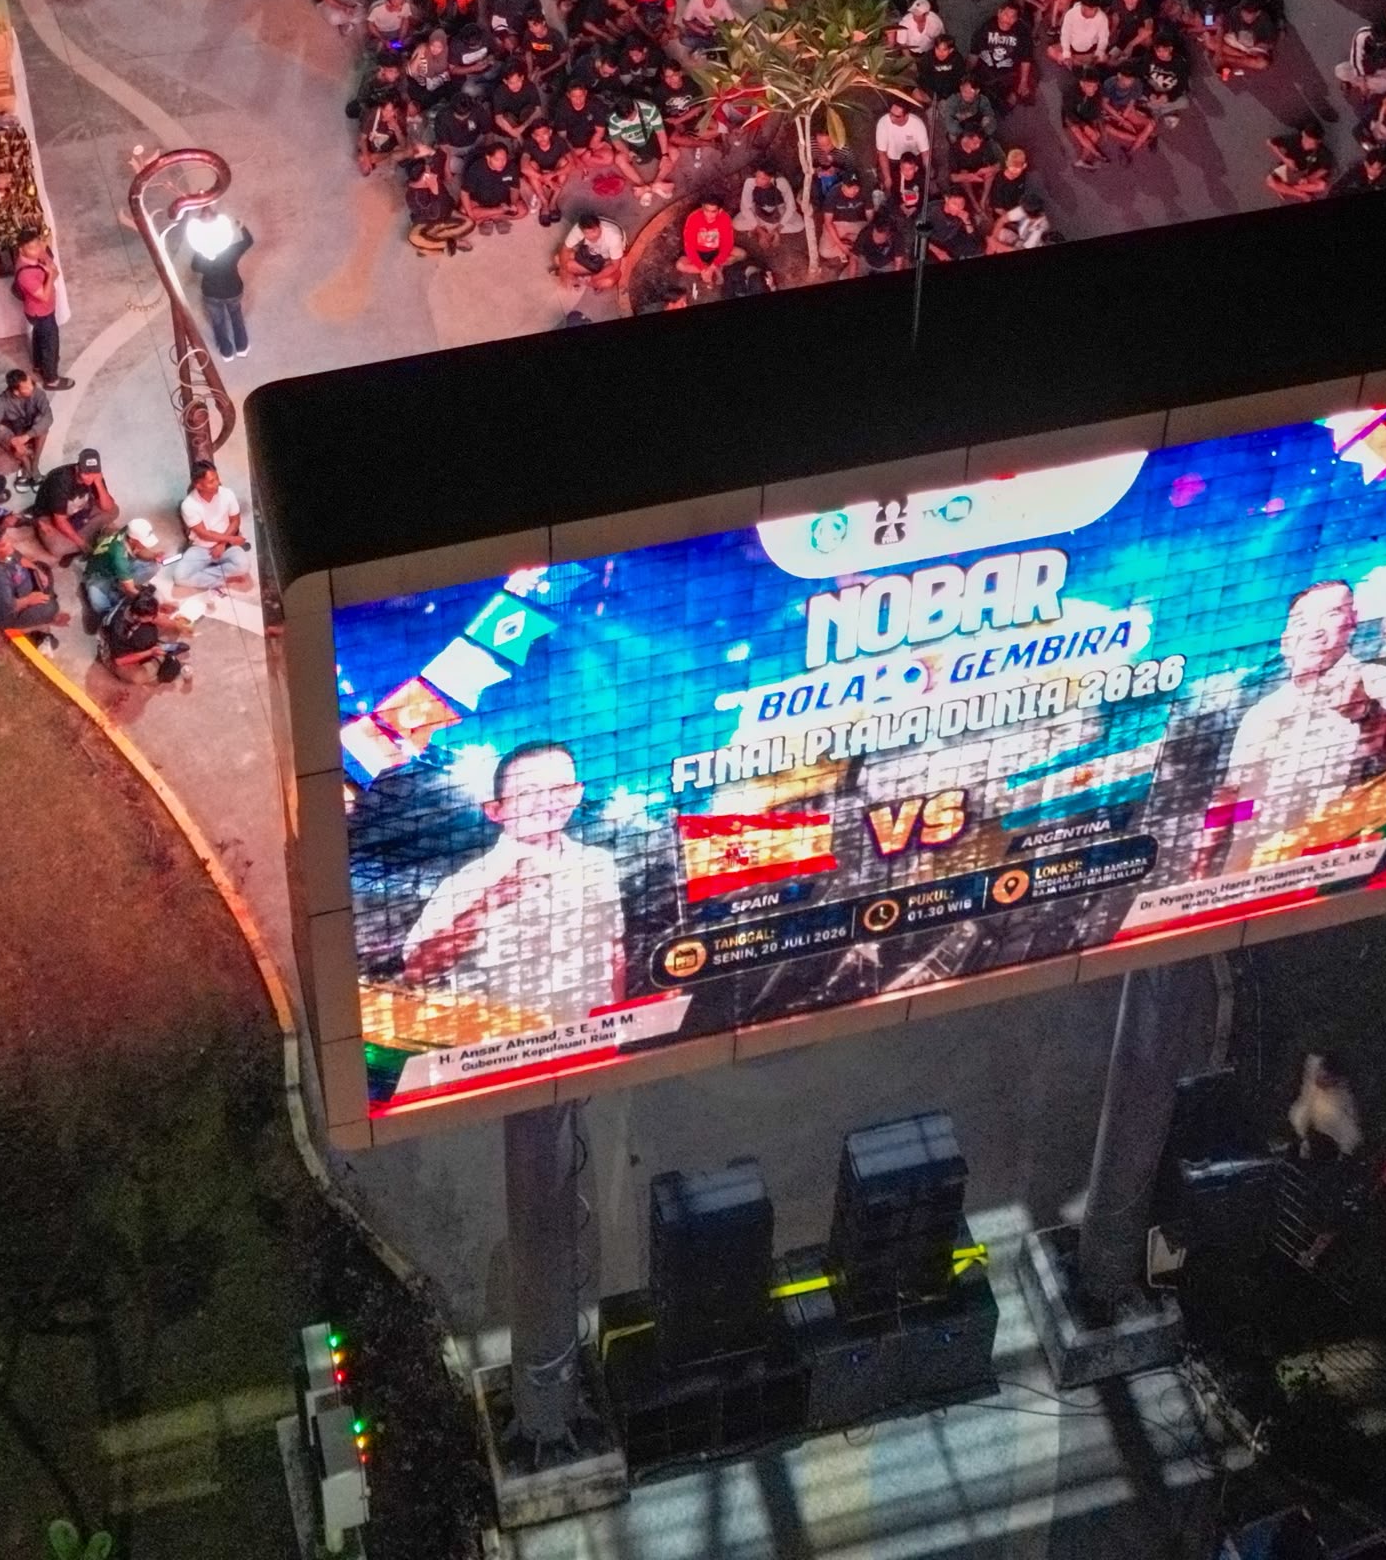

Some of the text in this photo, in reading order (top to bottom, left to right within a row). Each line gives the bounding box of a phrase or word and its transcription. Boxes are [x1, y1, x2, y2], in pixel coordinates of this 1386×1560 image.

[805, 549, 1068, 668] NOBAR
[758, 621, 1133, 723] BOLA GEMBIRA
[671, 655, 1187, 793] FINAL PIALA DUNIA 2026
[867, 789, 967, 858] VS
[1021, 820, 1111, 849] ARGENTINA
[1034, 859, 1083, 880] LOKASI:
[908, 890, 954, 907] PUKUL:
[1219, 878, 1251, 893] Haris
[730, 893, 780, 915] SPAIN
[907, 899, 973, 921] 01.30 WIB
[712, 927, 847, 965] SENIN, 20 JULI 2026
[713, 930, 775, 950] TANGGAL:
[439, 1054, 455, 1066] H.
[459, 1045, 502, 1061] Ansar
[506, 1032, 561, 1053] Ahmad,
[462, 1031, 617, 1072] Gubernur Kepulauan Riau
